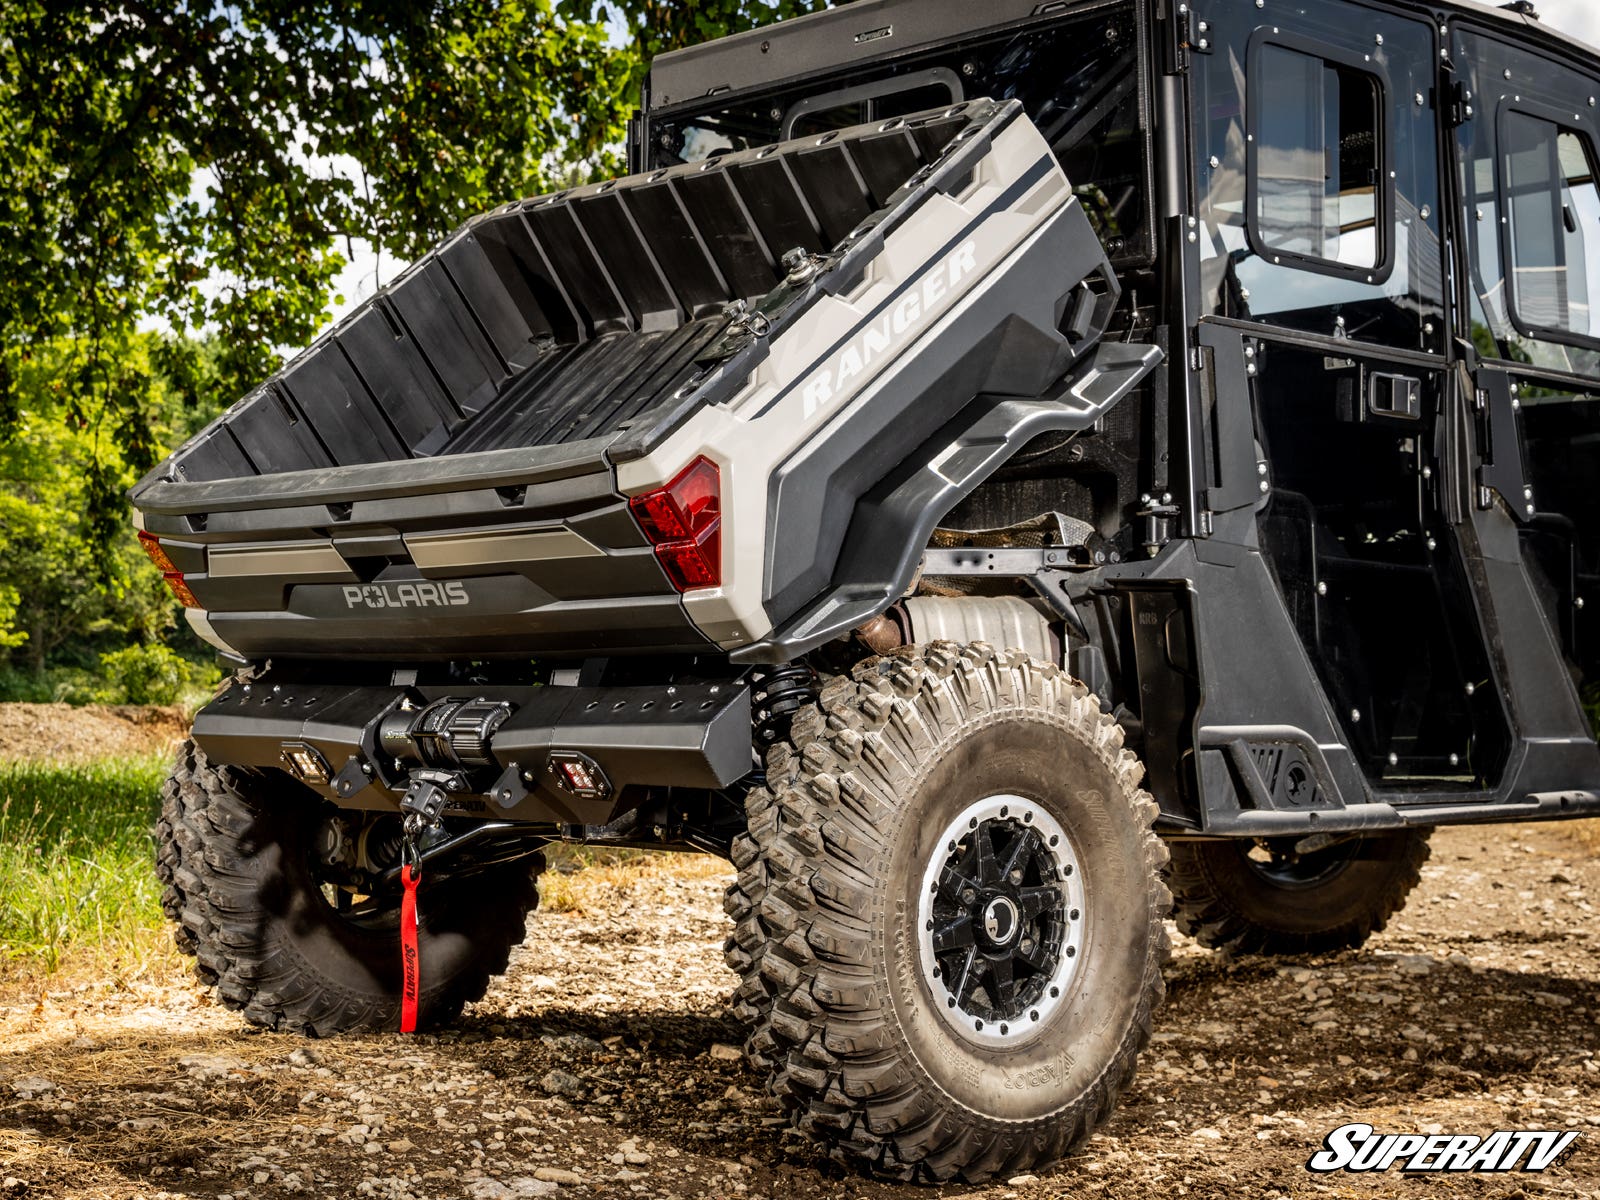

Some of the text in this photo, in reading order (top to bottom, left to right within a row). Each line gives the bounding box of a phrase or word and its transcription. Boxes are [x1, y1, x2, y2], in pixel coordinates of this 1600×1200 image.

[802, 240, 977, 420] RANGER
[342, 581, 469, 609] POLARIS
[404, 943, 416, 1002] SUPERATV
